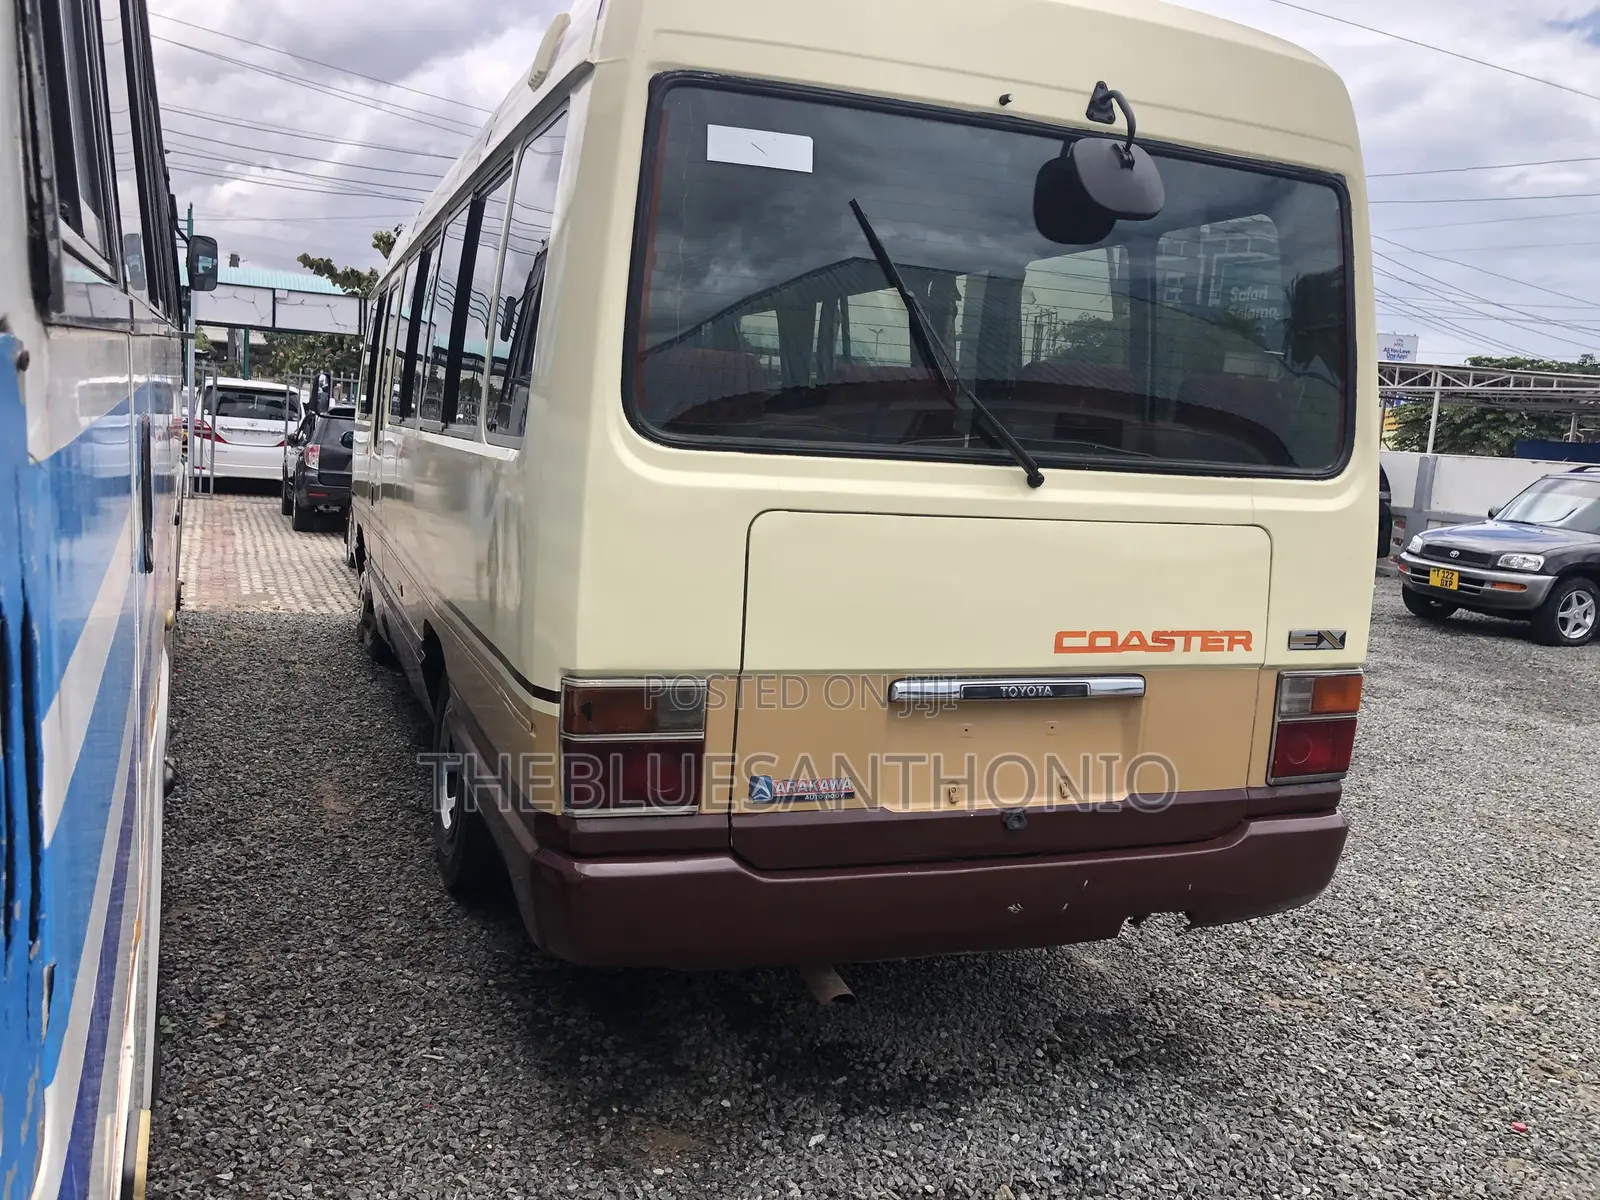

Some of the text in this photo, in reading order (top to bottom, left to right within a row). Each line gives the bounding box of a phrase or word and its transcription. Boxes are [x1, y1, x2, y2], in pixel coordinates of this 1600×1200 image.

[1441, 570, 1455, 580] 122
[1440, 579, 1454, 588] DXP
[1054, 630, 1253, 654] COASTER
[1288, 629, 1347, 650] EX
[1000, 685, 1053, 697] TOYOTA
[775, 777, 852, 794] ARAKAWA
